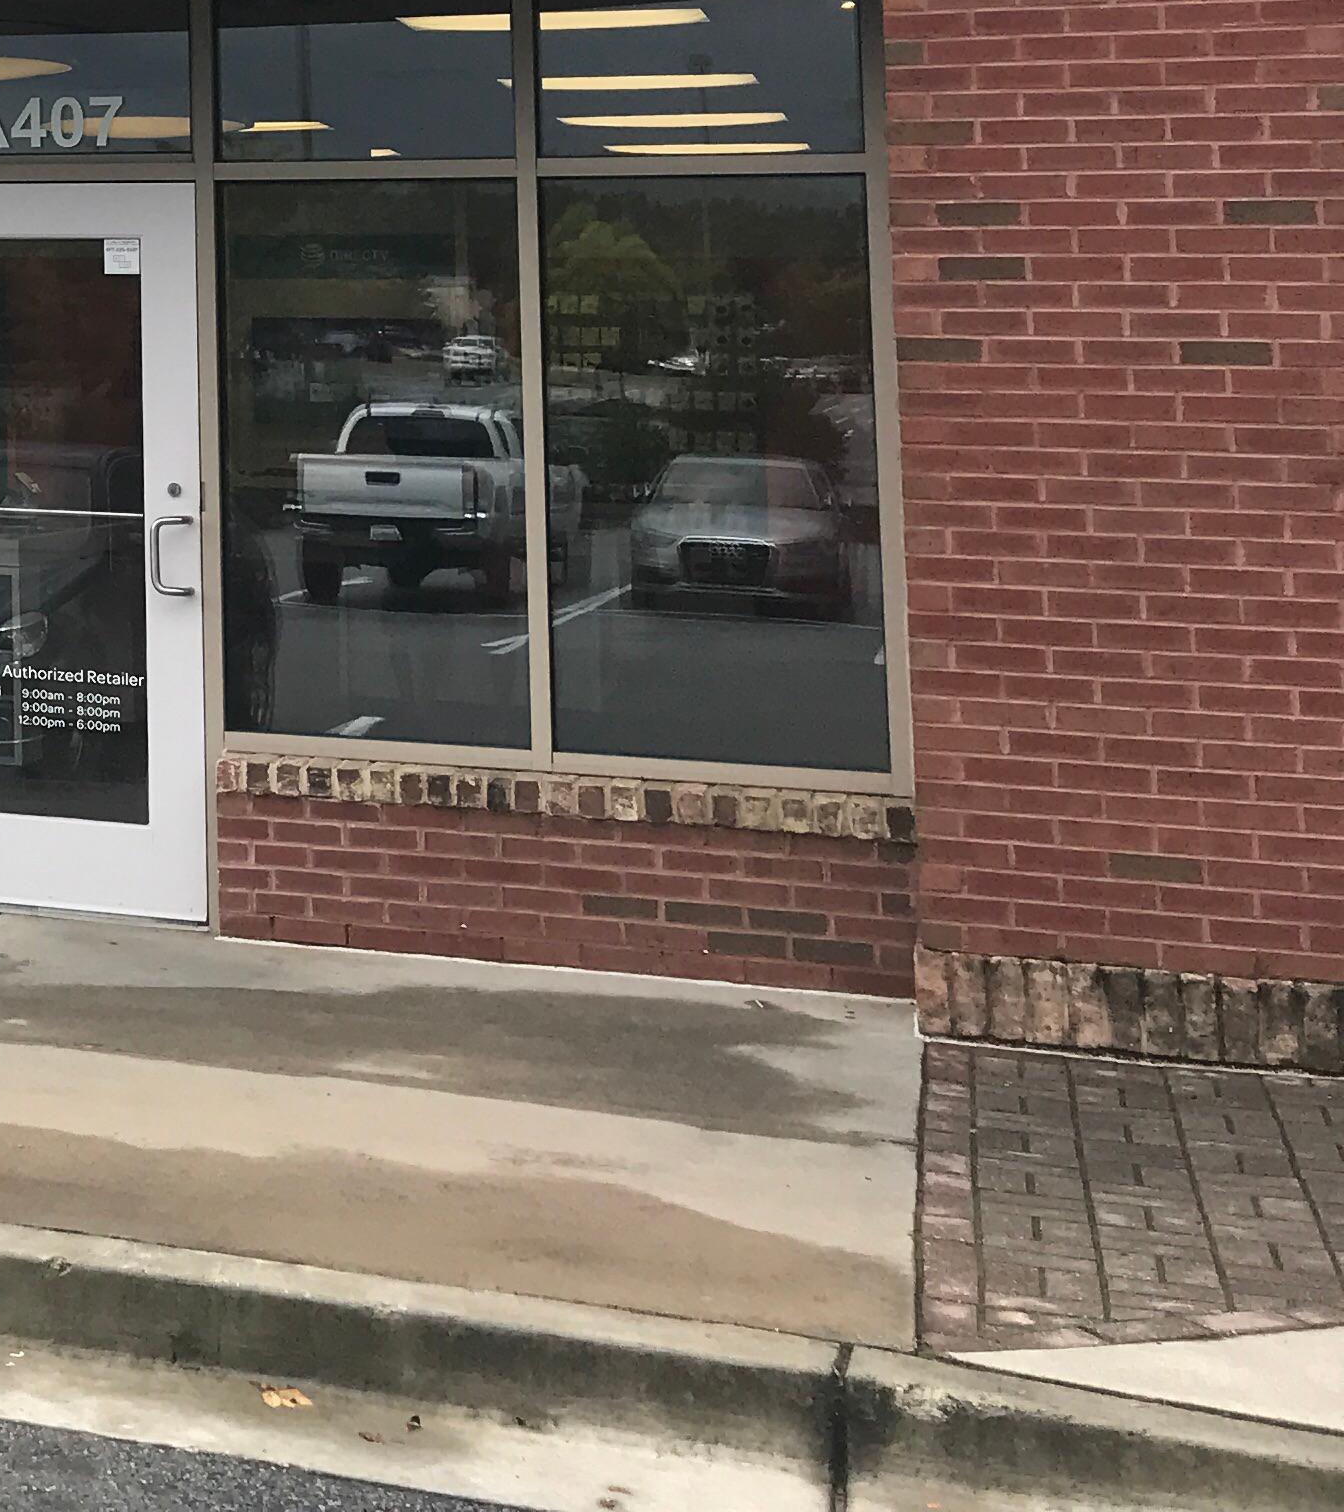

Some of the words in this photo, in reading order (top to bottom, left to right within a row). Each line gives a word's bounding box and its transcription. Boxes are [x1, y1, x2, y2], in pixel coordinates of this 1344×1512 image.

[2, 664, 84, 683] Authorized
[87, 670, 145, 687] Retailer
[21, 688, 65, 701] 9:00am
[76, 692, 121, 705] 8:00pm
[21, 702, 65, 715] 9:00am
[76, 705, 121, 719] 8:00pm
[18, 715, 65, 729] 12:00pm
[76, 719, 121, 733] 6:00pm
